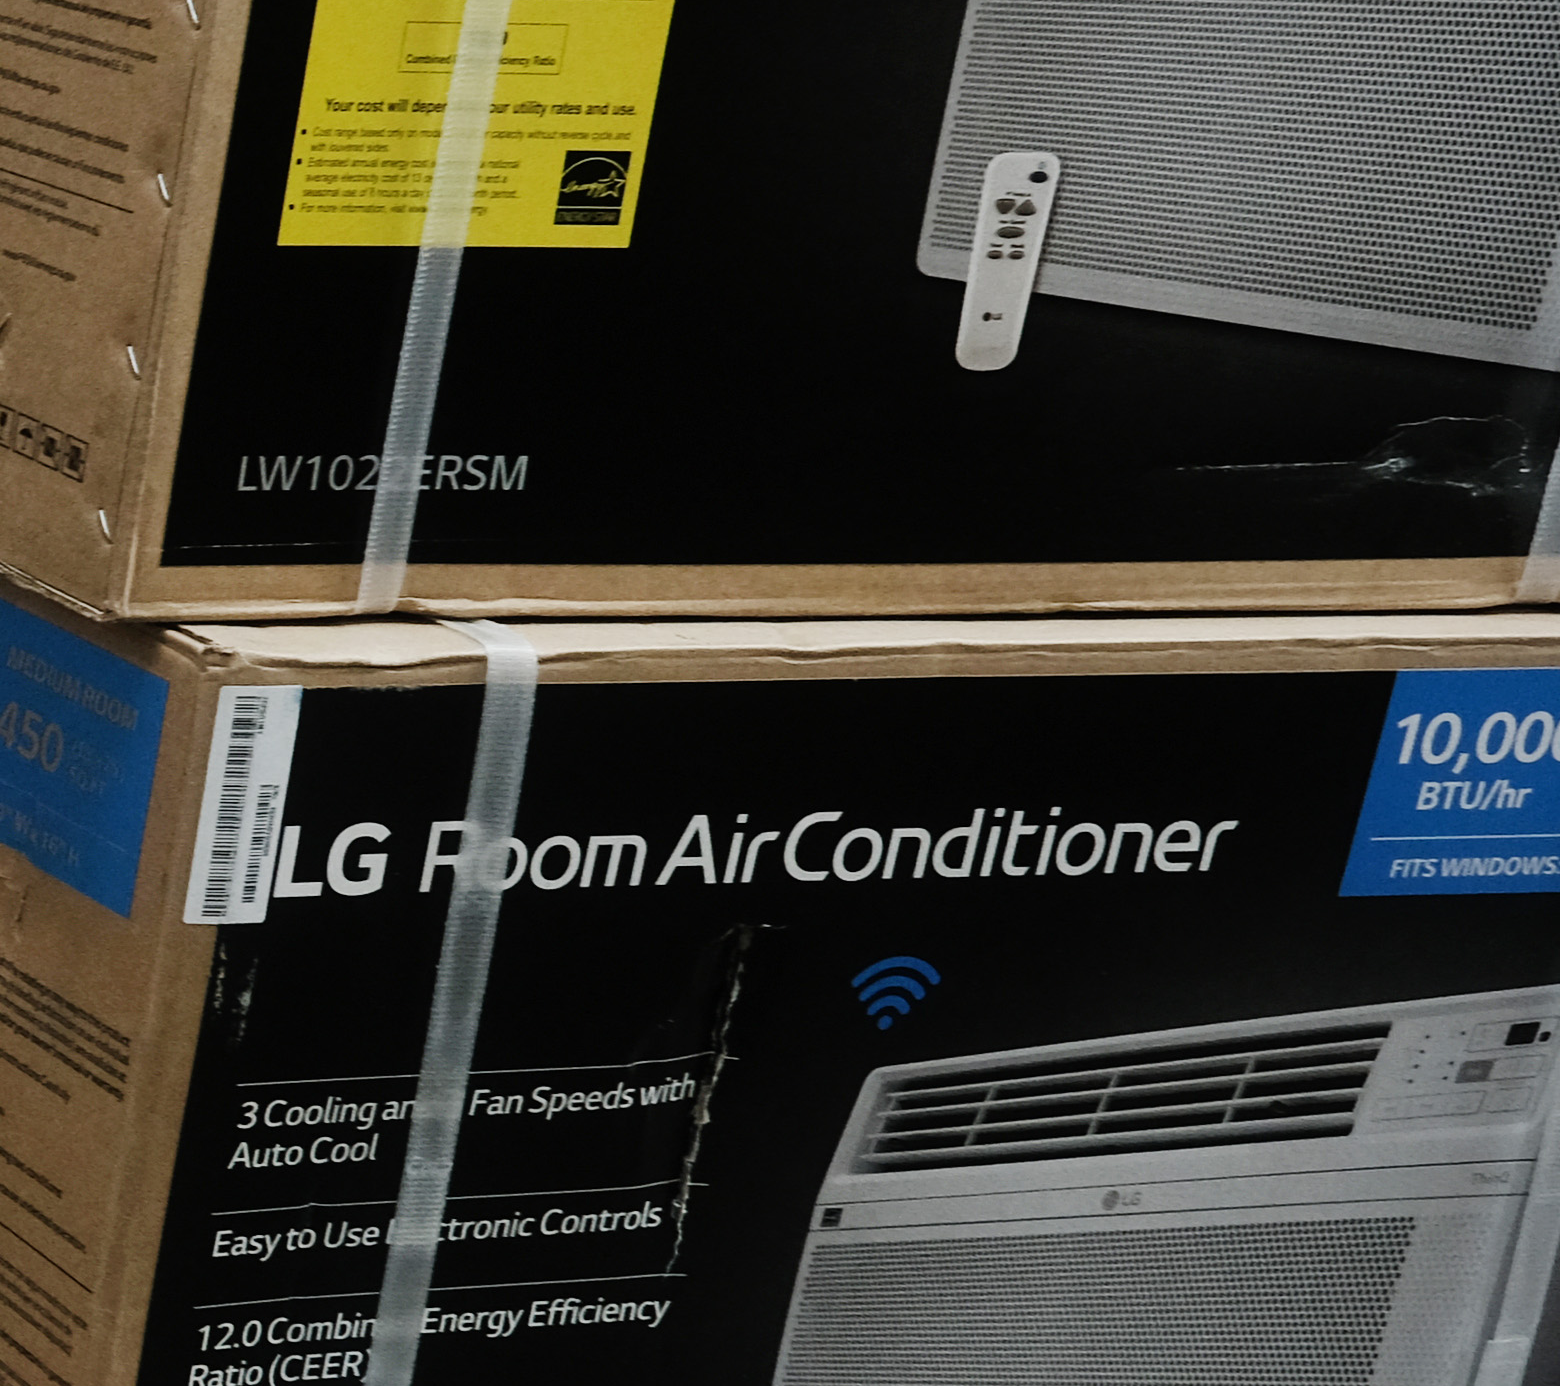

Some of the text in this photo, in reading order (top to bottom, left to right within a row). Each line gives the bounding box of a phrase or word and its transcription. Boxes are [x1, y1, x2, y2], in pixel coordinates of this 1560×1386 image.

[1415, 779, 1533, 811] BTU/hr
[273, 821, 393, 900] LG
[418, 819, 648, 893] Room
[196, 1296, 672, 1352] 12.0 Efficiency
